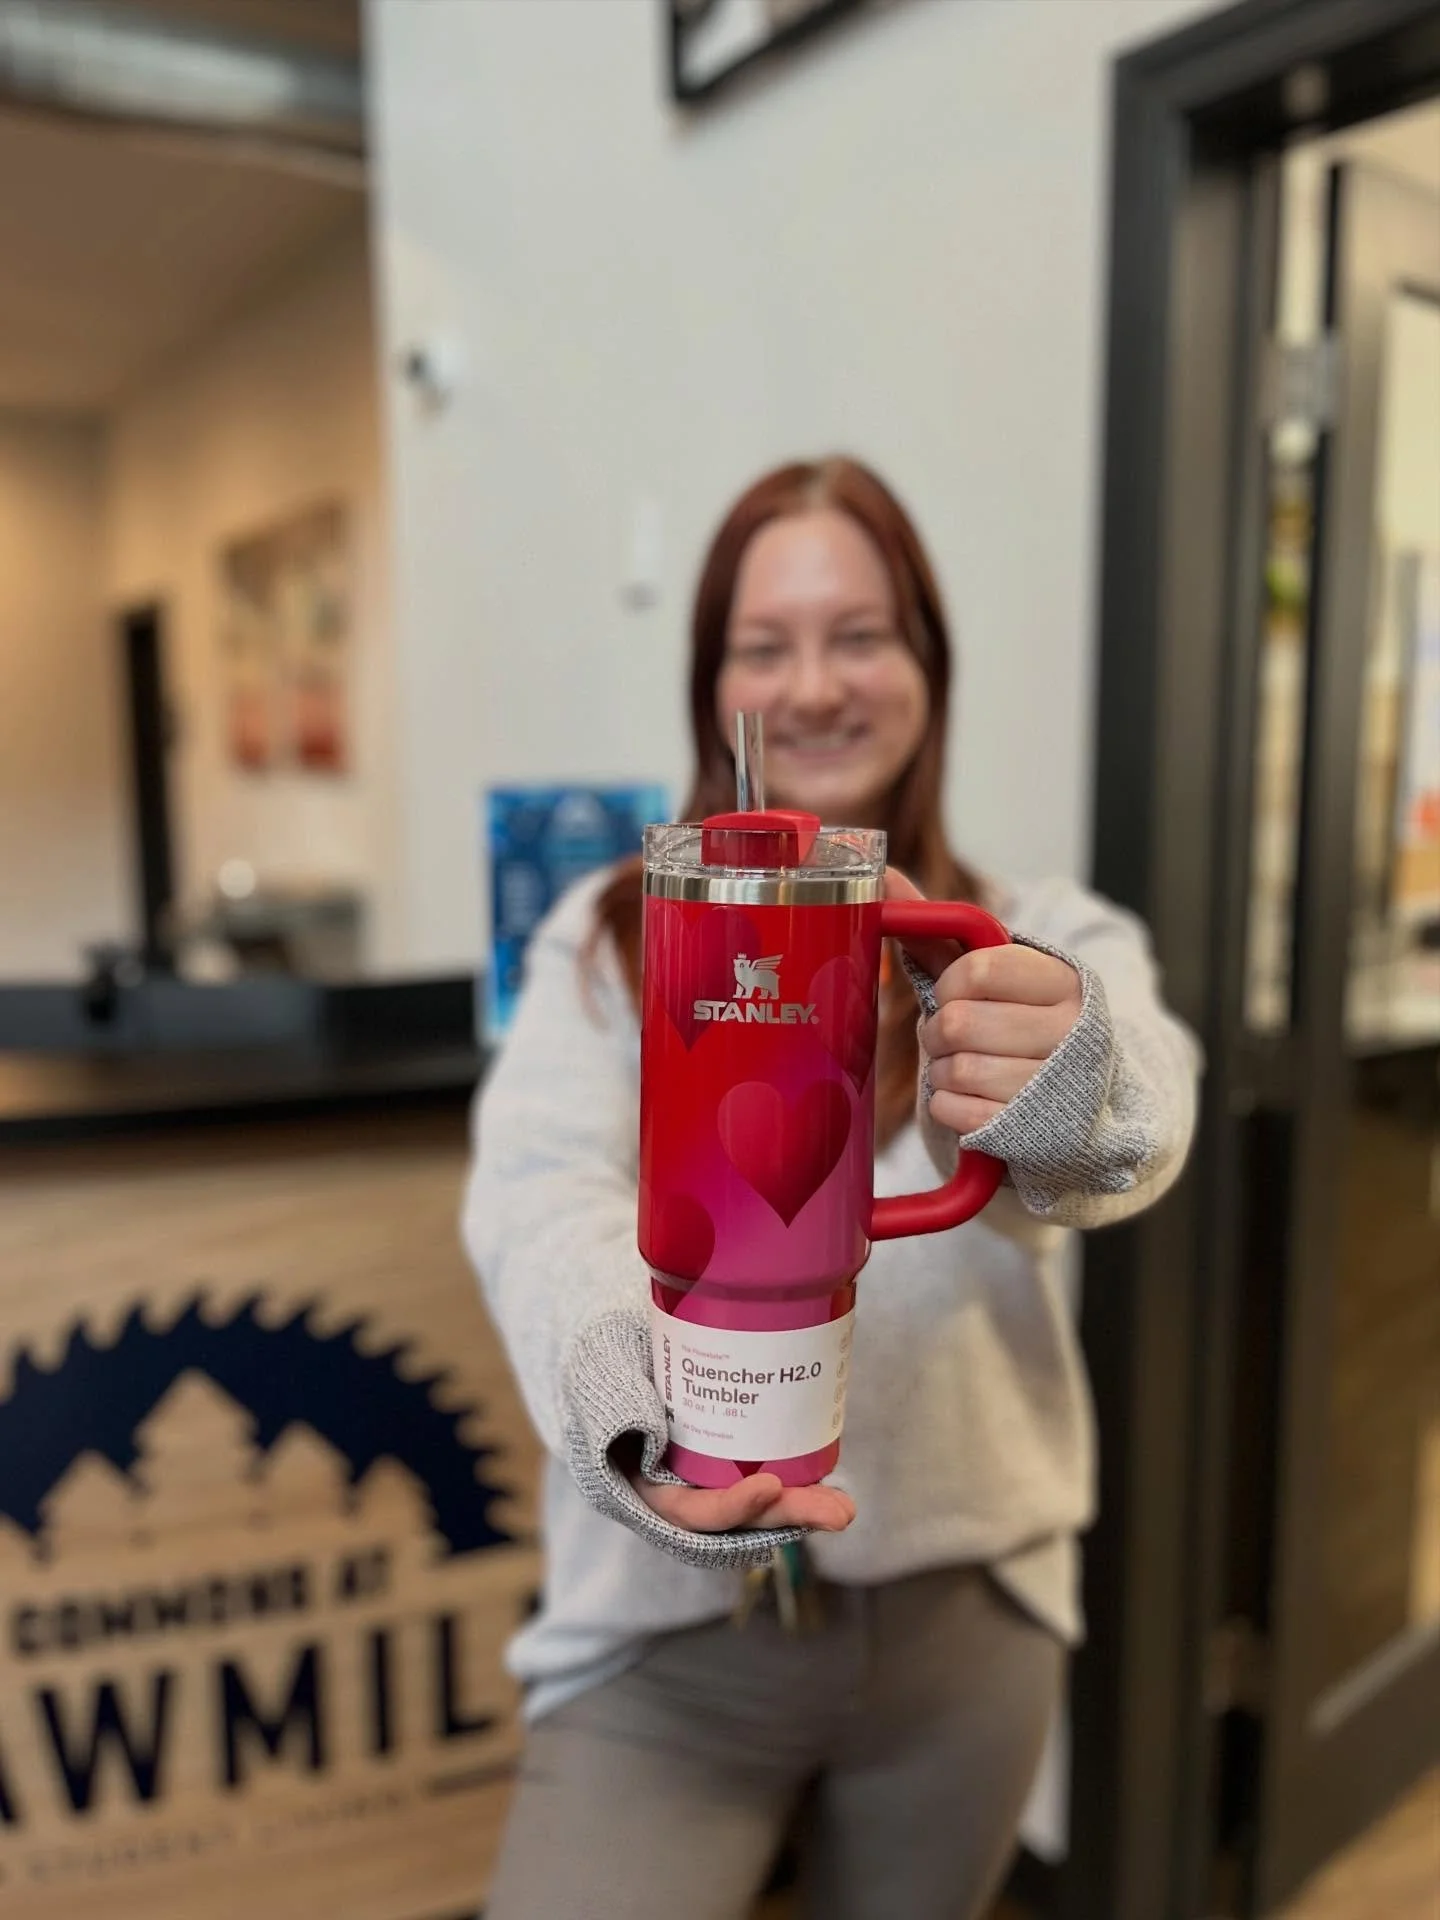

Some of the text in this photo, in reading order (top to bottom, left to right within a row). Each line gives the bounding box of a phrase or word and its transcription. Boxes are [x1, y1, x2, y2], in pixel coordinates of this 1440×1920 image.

[662, 1333, 673, 1403] STANLEY
[681, 1357, 822, 1385] Quencher H2.0
[681, 1377, 760, 1405] Tumbler
[740, 1409, 748, 1419] L
